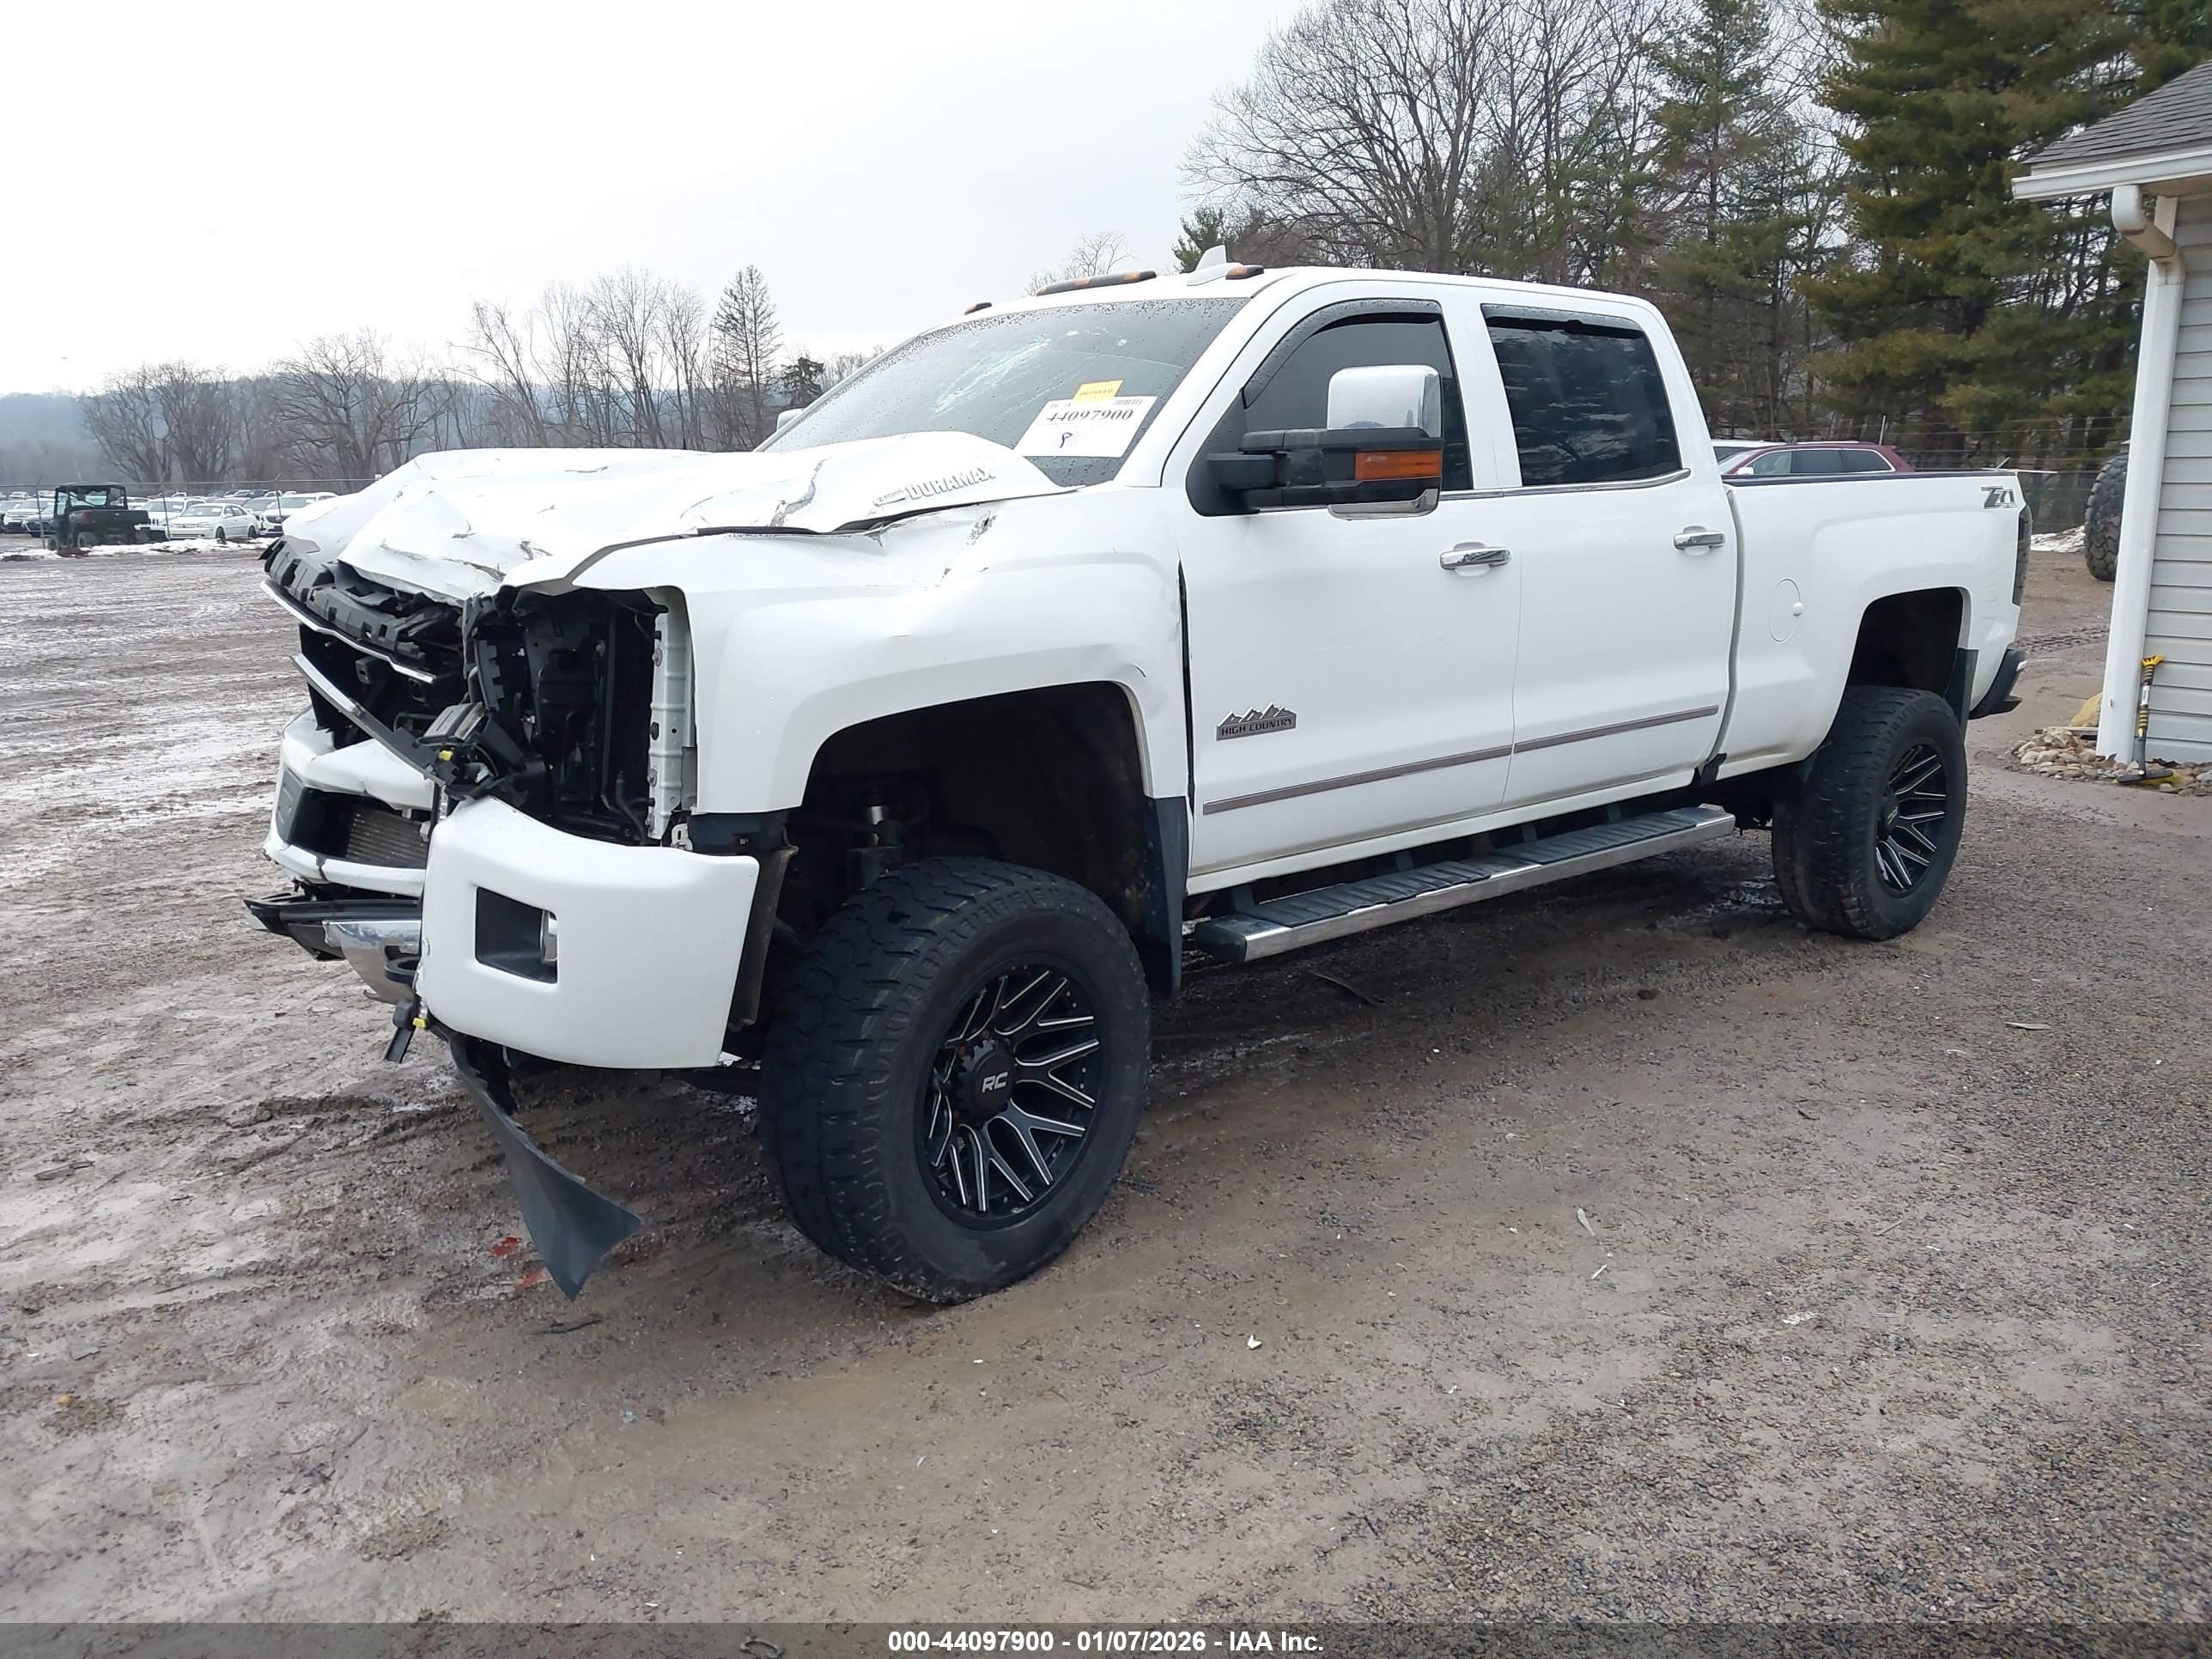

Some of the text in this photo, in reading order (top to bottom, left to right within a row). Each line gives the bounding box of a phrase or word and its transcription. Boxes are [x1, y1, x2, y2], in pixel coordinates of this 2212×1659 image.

[1046, 409, 1134, 422] 44097900
[905, 467, 996, 501] DURAMAX
[1980, 486, 2015, 509] Z71
[1221, 719, 1291, 735] HIGH COUNTRY
[981, 1071, 1009, 1093] RC
